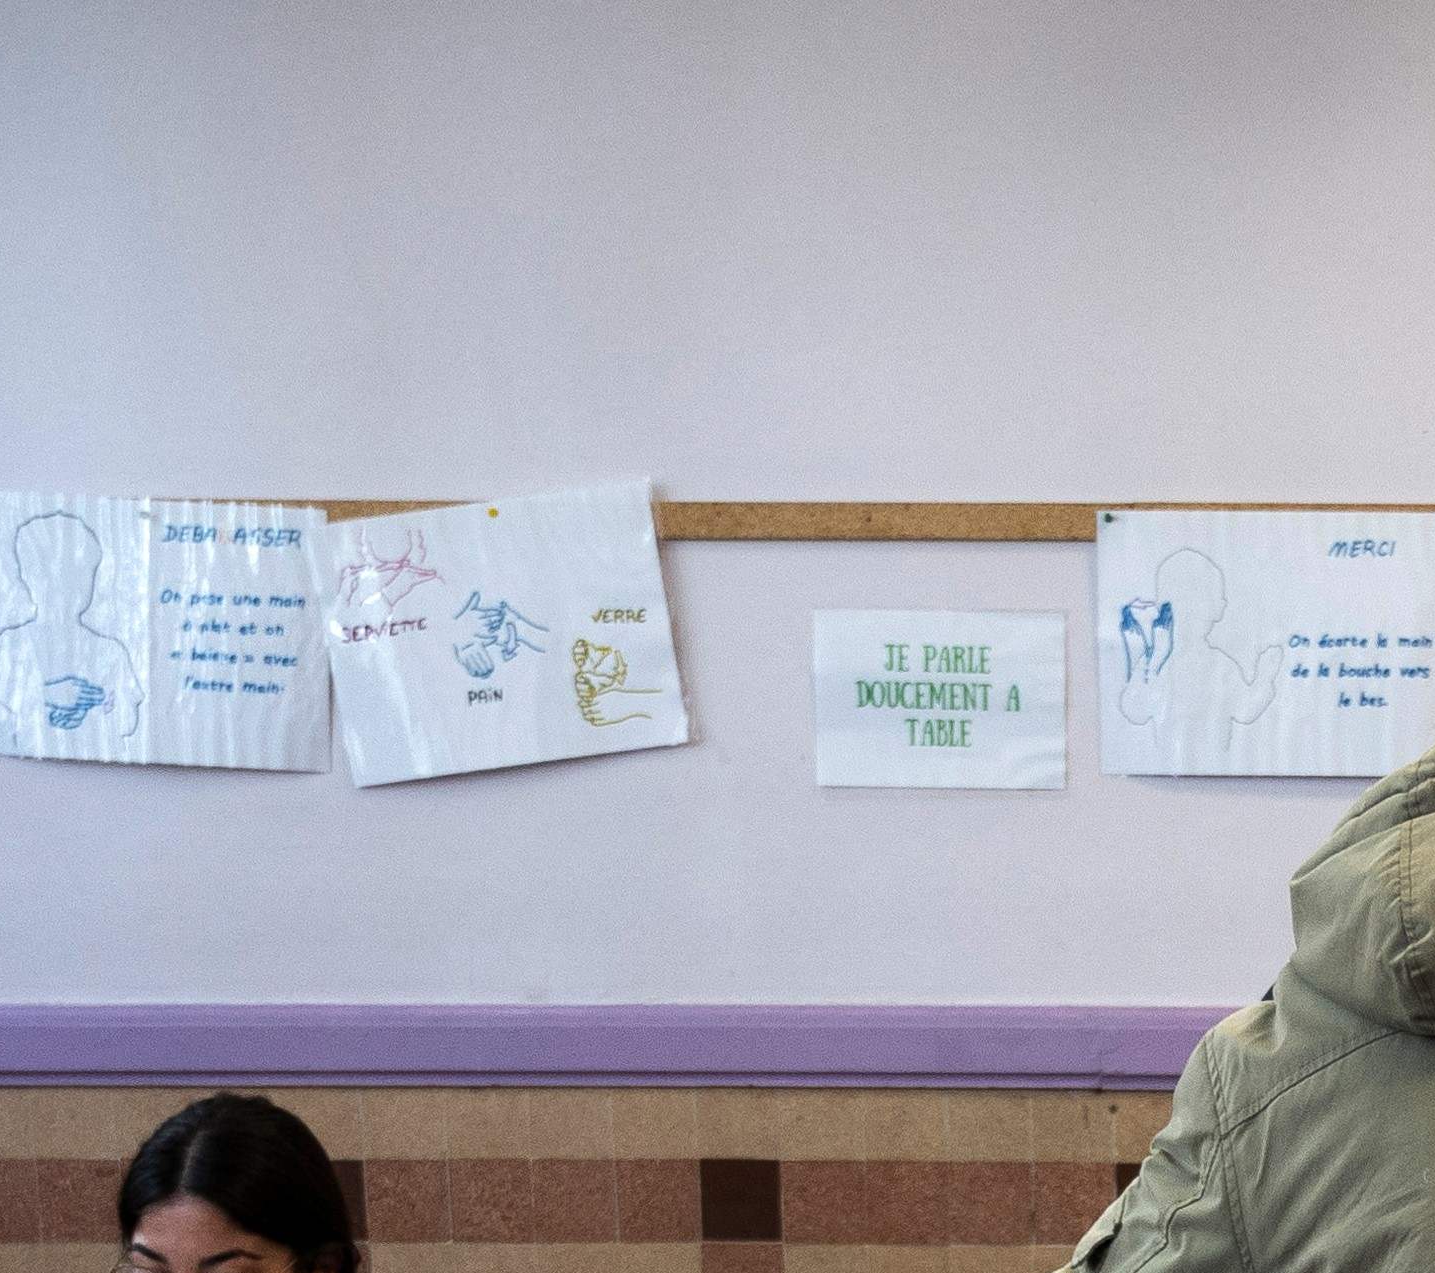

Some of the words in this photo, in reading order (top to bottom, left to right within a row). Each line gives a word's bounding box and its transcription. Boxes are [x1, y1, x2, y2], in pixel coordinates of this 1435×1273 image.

[1328, 539, 1396, 557] MERCI
[1288, 634, 1311, 648] On
[884, 644, 909, 673] JE
[923, 645, 992, 675] PARLE
[856, 680, 993, 711] DOUCEMENT
[1005, 683, 1021, 712] A
[905, 718, 973, 748] TABLE
